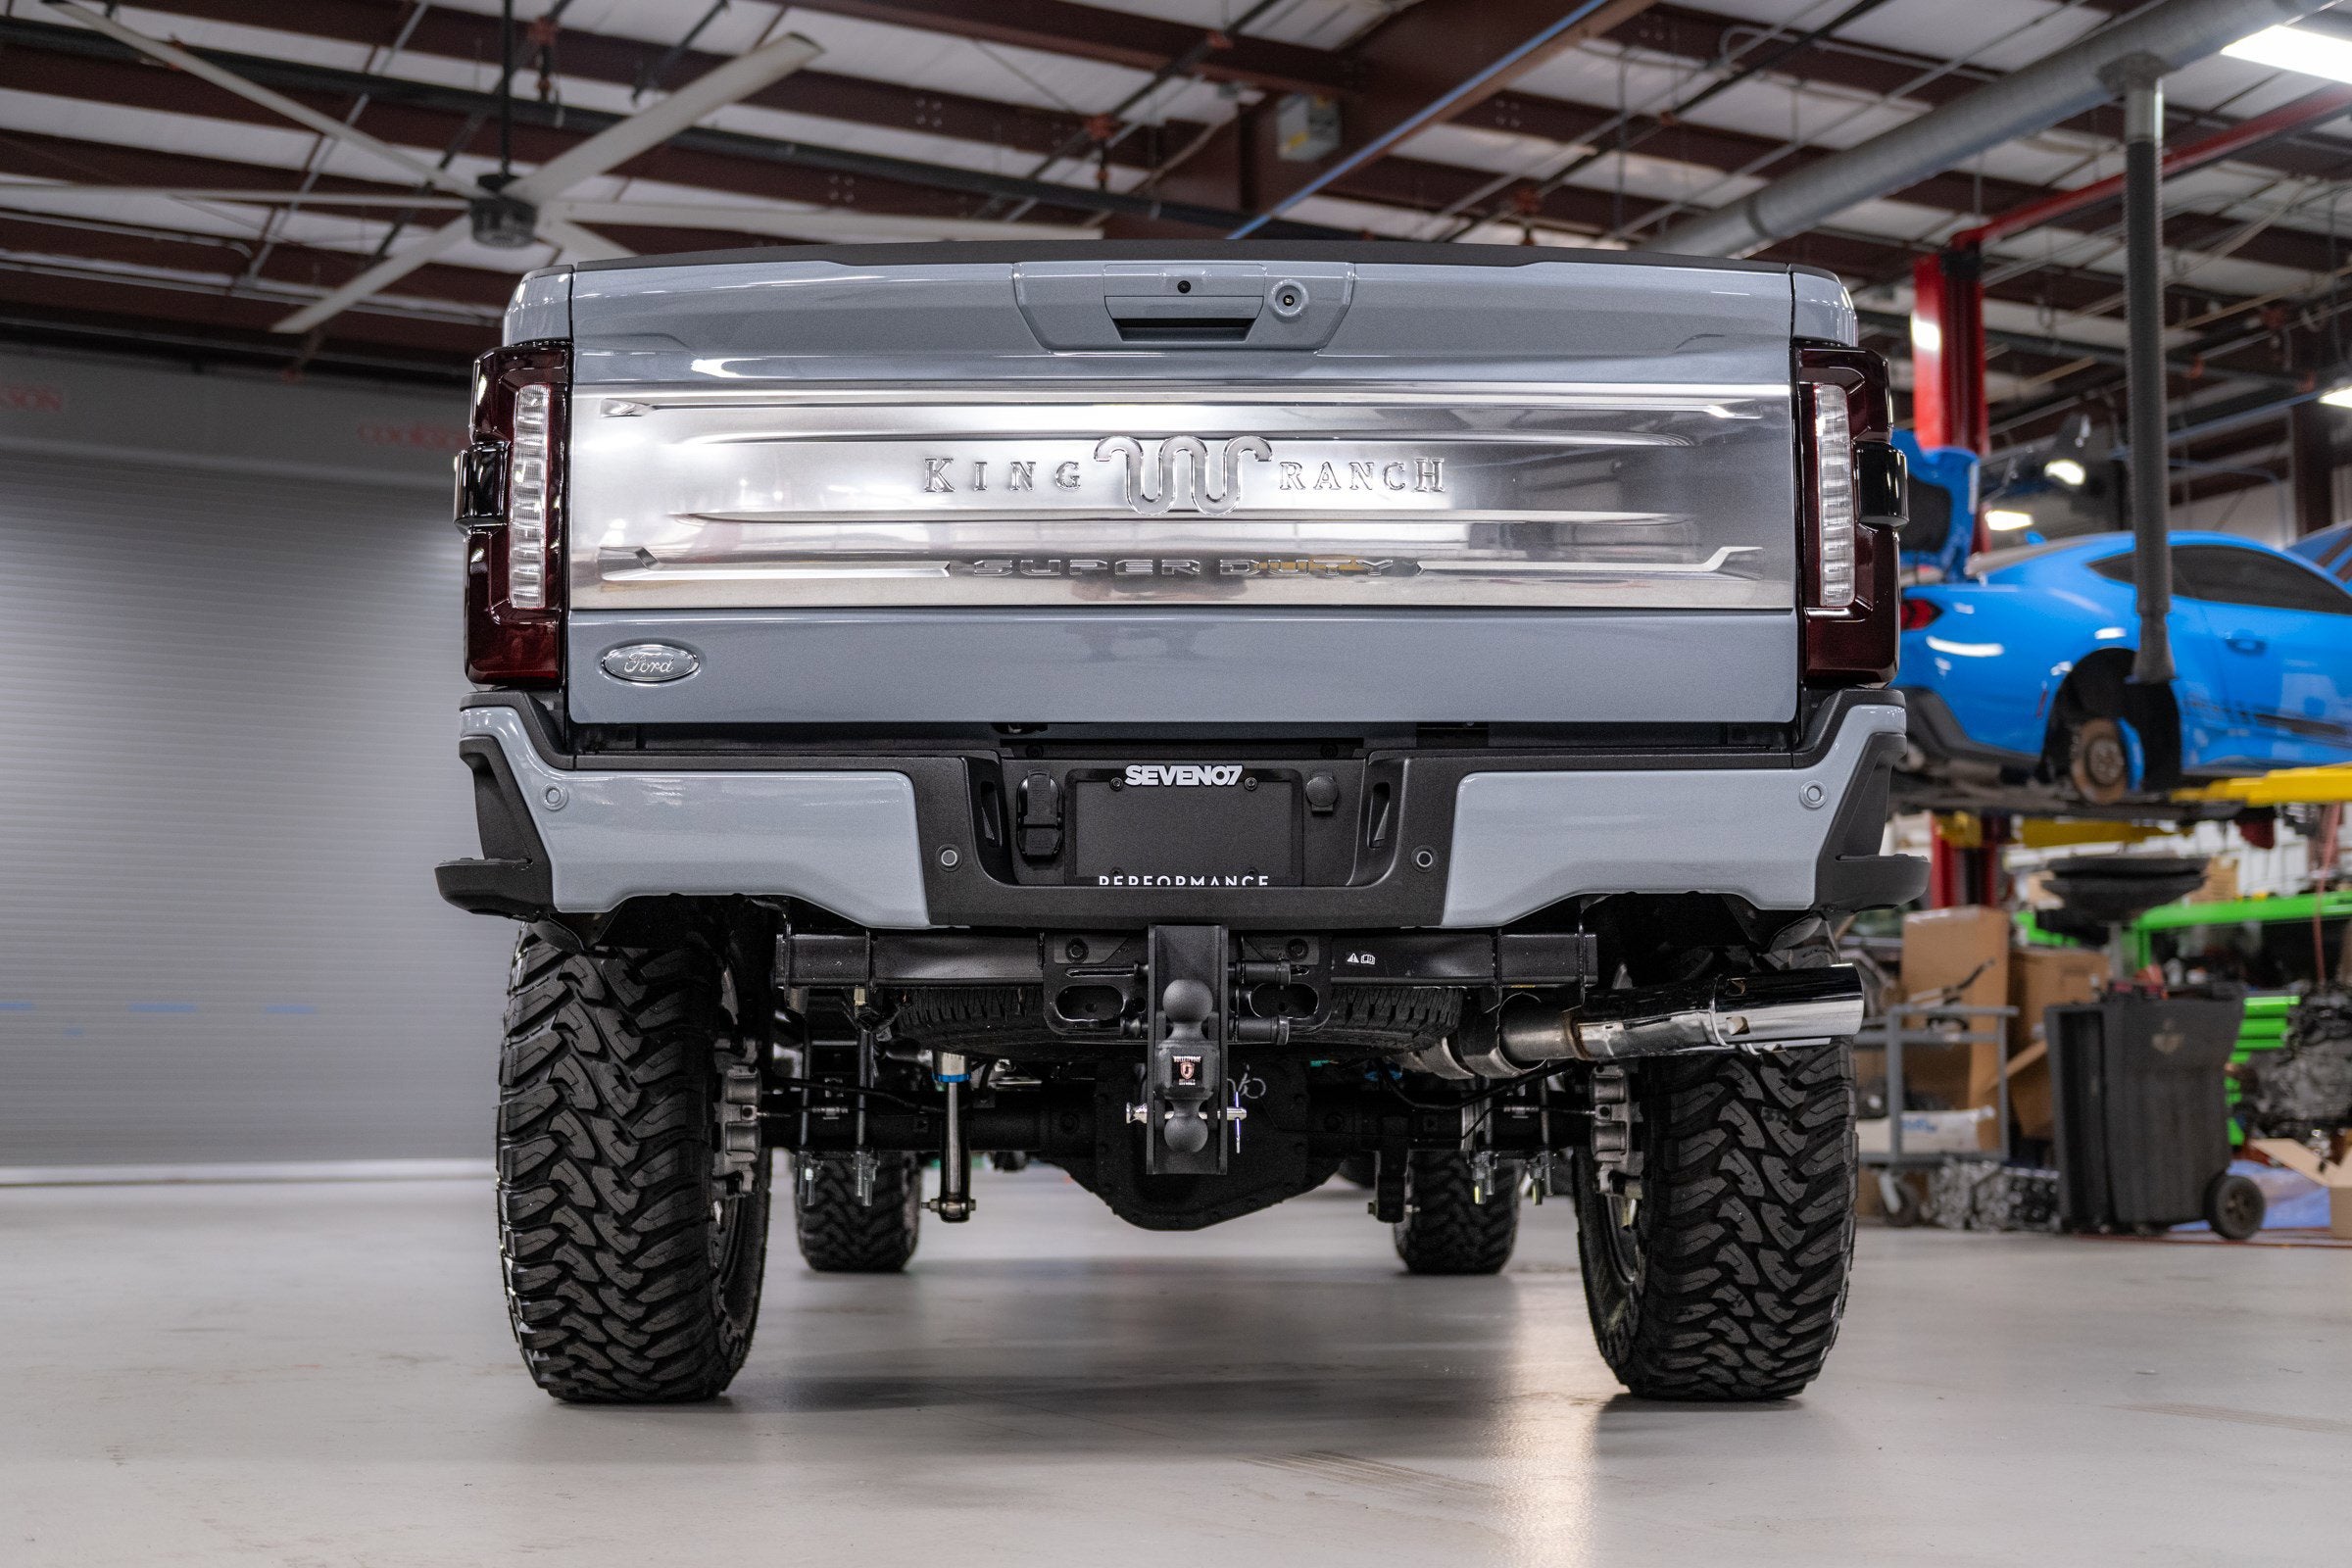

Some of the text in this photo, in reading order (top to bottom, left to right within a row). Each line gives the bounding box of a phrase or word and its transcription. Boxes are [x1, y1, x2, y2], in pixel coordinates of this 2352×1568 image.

[924, 457, 1446, 493] KING RANCH
[973, 559, 1394, 576] SUPER DUTY
[623, 651, 675, 673] Ford
